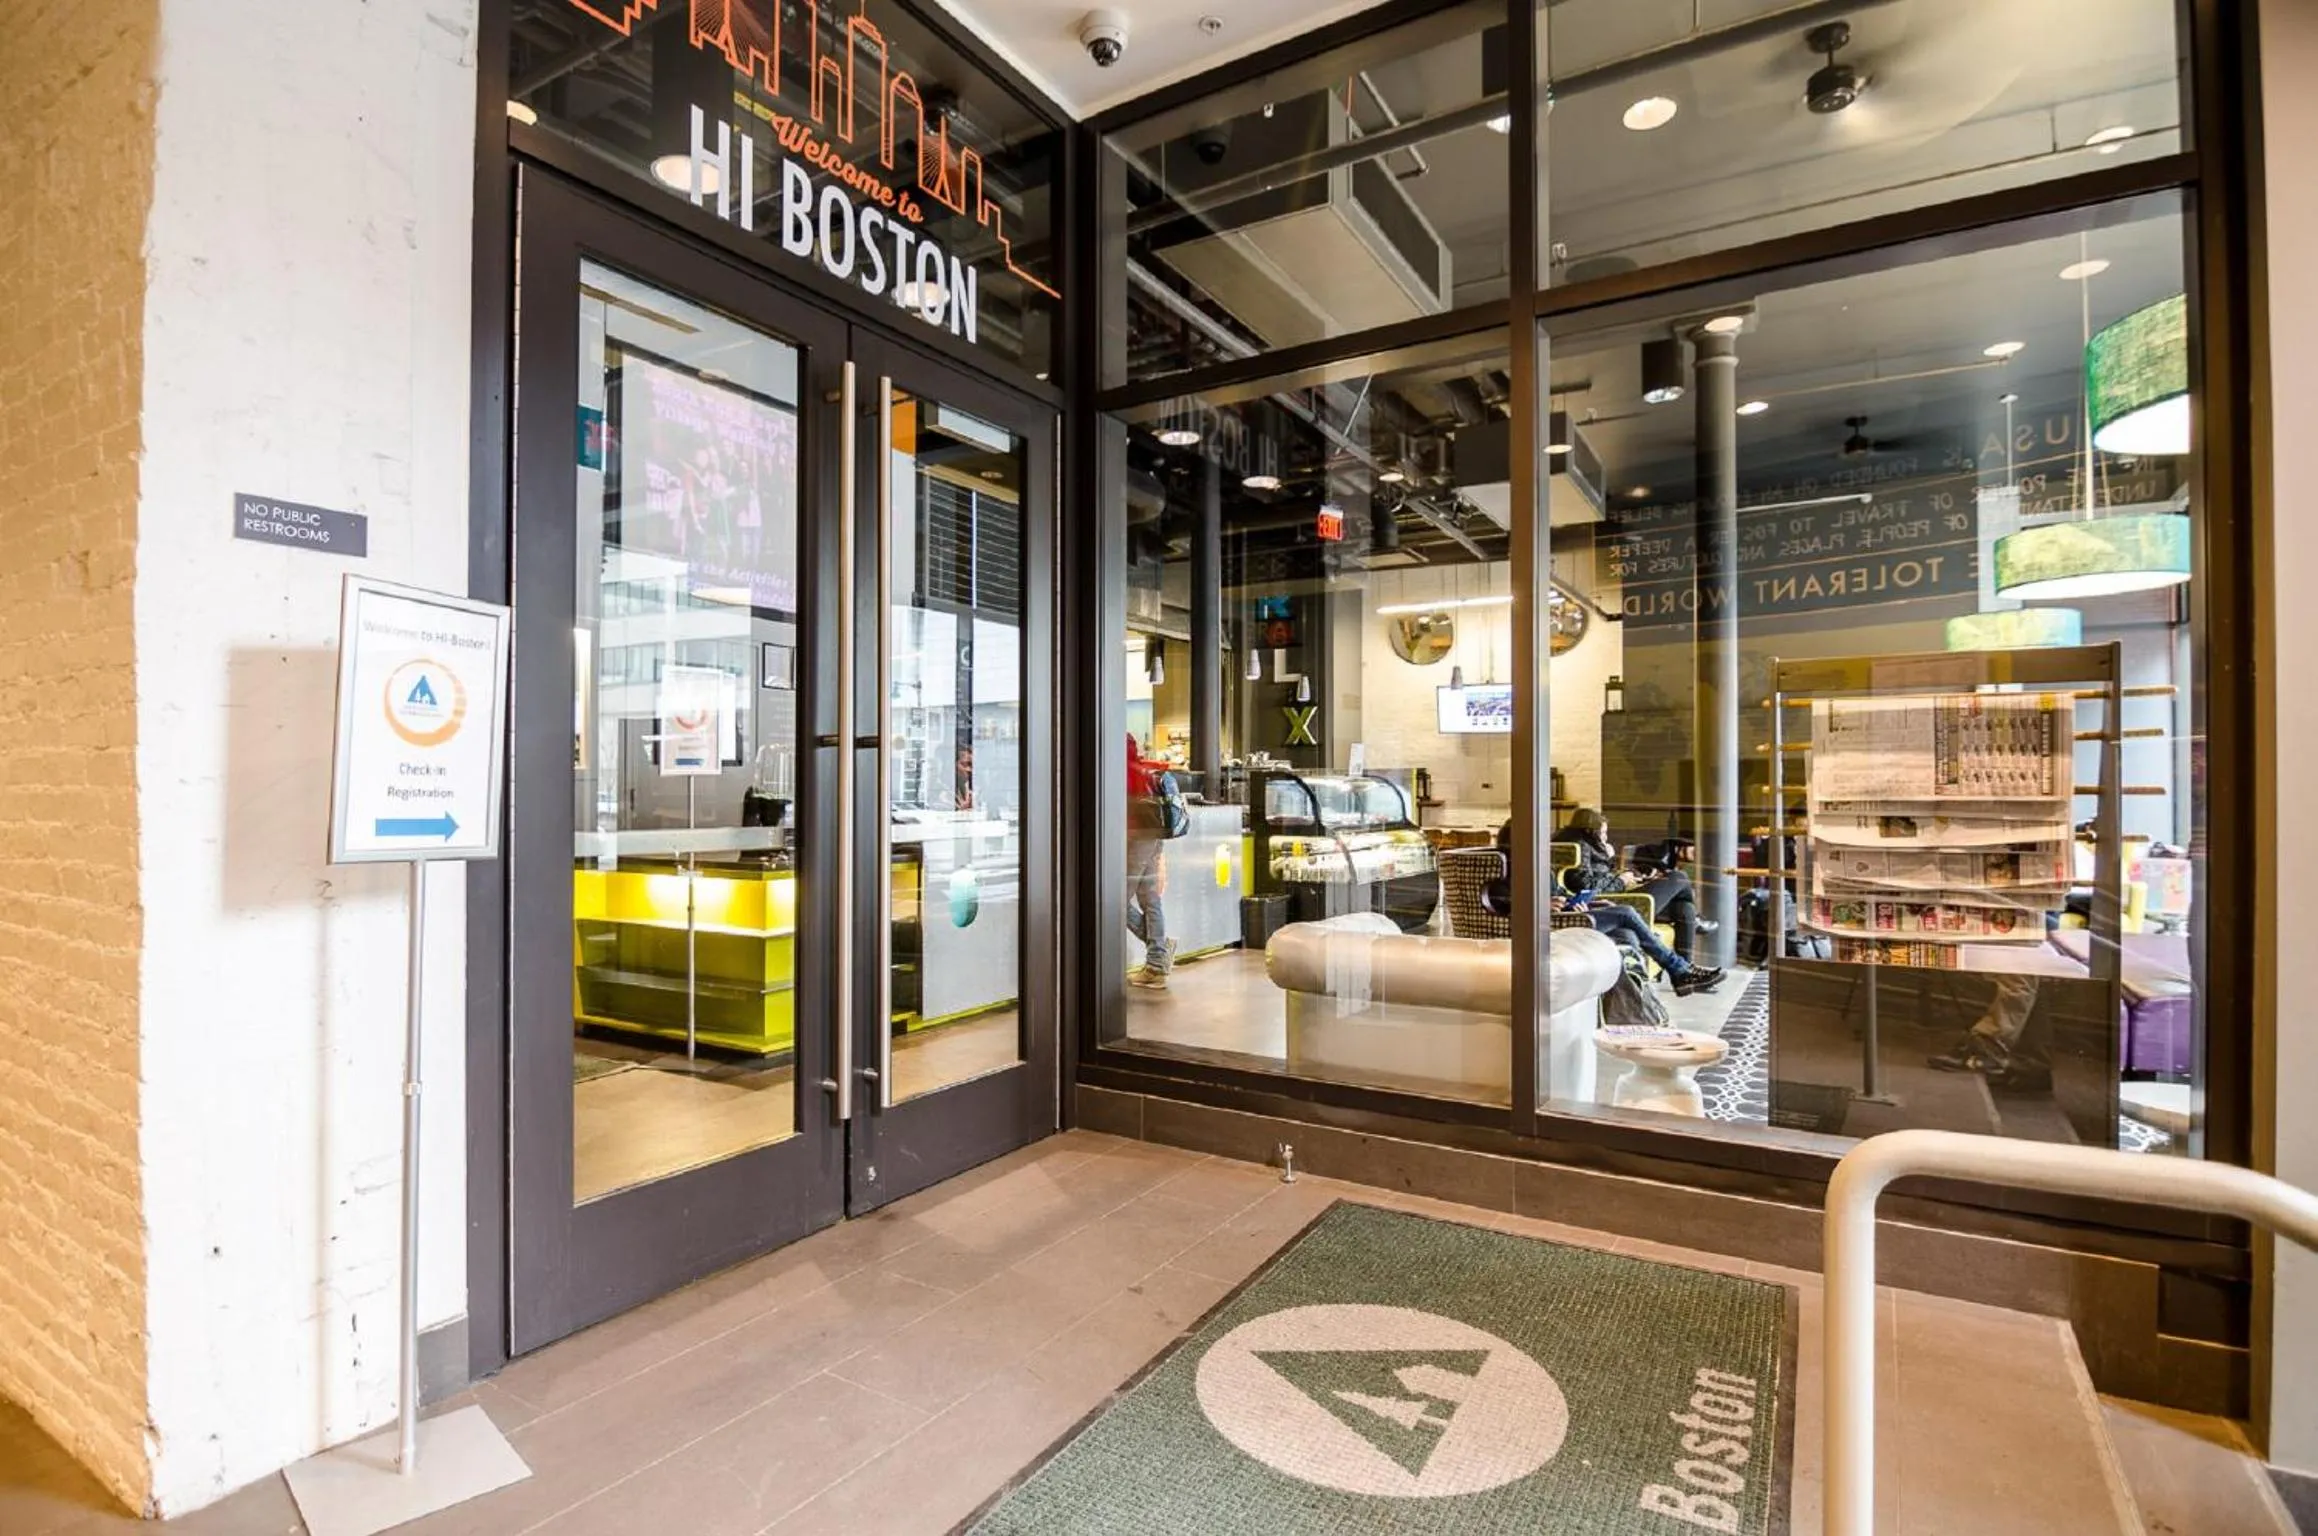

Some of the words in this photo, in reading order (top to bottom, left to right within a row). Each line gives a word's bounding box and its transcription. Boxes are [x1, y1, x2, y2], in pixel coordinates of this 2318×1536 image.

[770, 112, 894, 210] Welcome
[897, 184, 925, 224] to
[690, 104, 754, 232] HI
[781, 156, 978, 345] BOSTON
[243, 501, 268, 516] NO
[273, 506, 321, 526] PUBLIC
[243, 518, 331, 543] RESTROOMS
[420, 630, 434, 643] to
[387, 785, 455, 800] Registration
[1640, 1368, 1757, 1535] Boston
